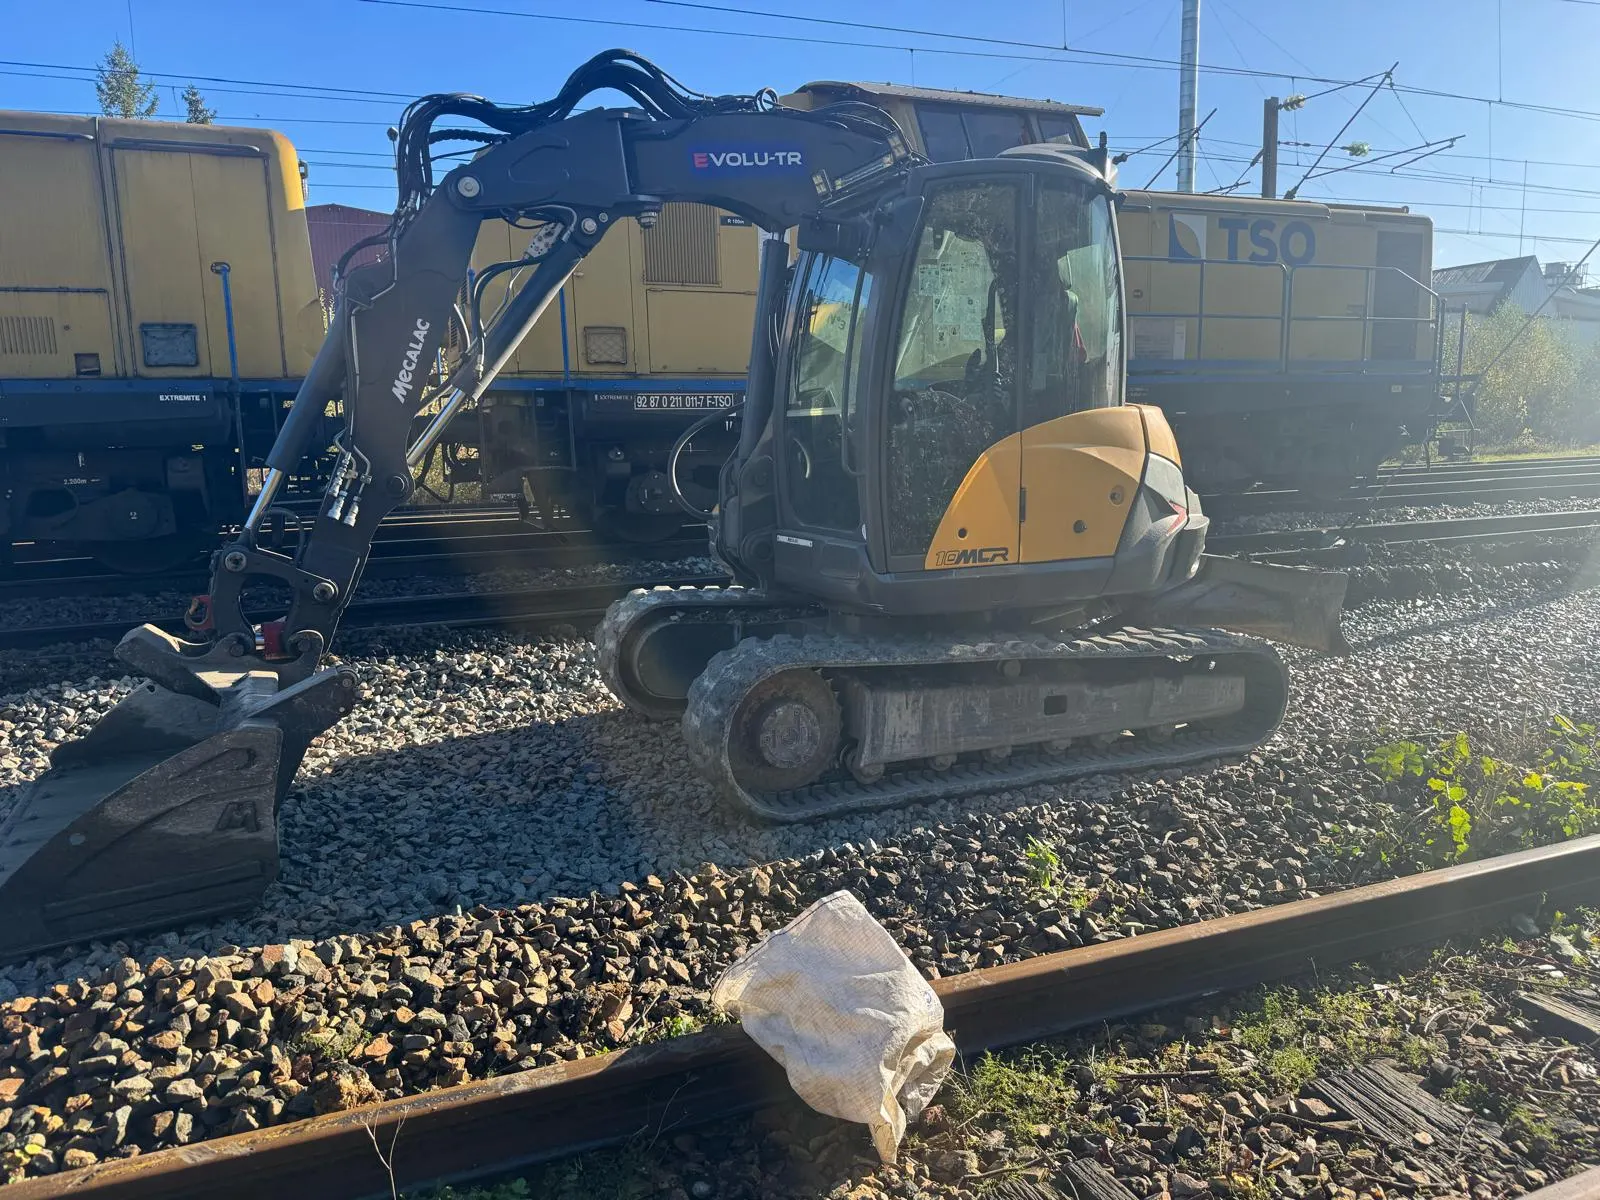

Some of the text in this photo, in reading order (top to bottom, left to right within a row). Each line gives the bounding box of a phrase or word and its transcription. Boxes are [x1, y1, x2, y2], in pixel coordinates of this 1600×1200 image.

[693, 151, 803, 168] EVOLU-TR
[1218, 217, 1316, 268] TSO
[636, 395, 732, 408] 92 87 0 211 011-7 F-TSO
[935, 547, 1009, 567] 10MCR
